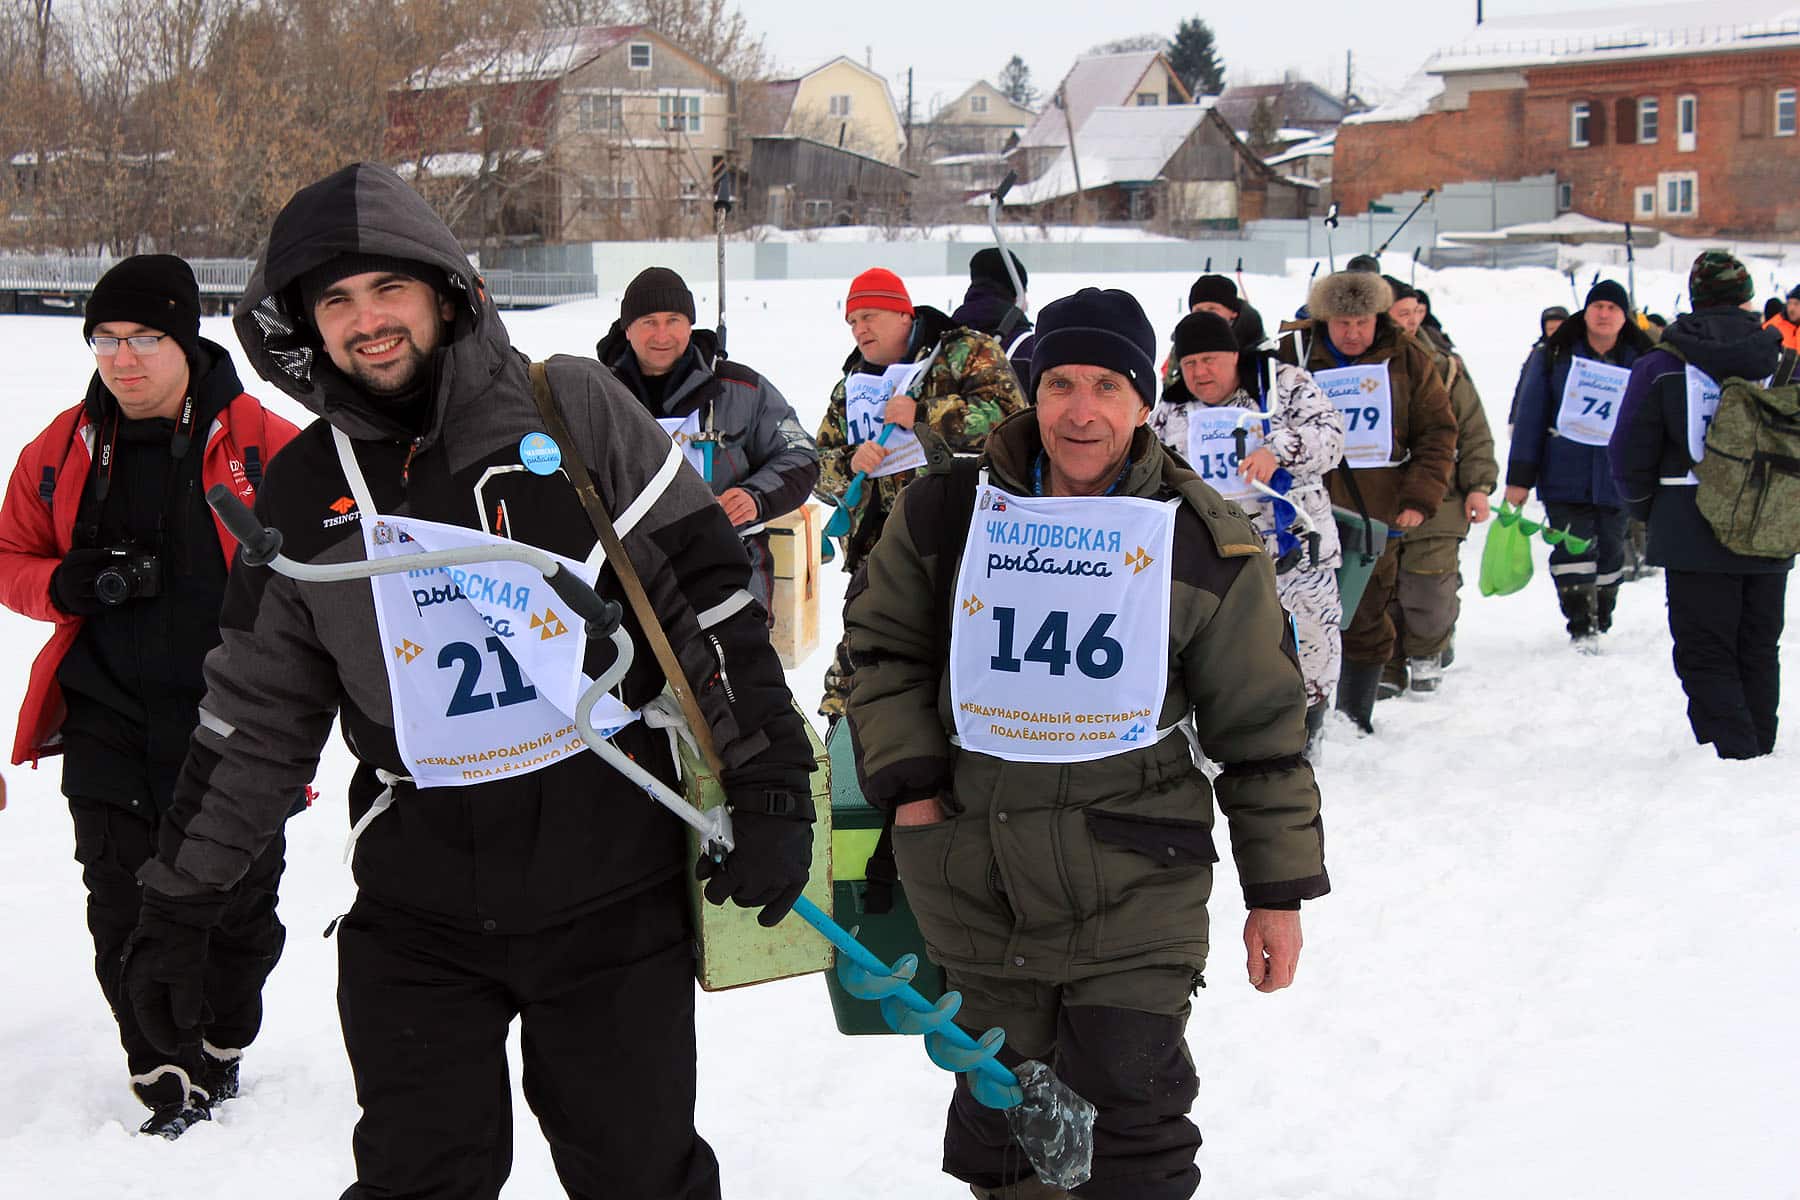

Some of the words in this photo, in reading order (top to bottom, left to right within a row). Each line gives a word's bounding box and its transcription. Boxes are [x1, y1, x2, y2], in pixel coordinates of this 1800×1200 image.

[182, 396, 192, 424] Canon
[1337, 407, 1380, 431] 79
[1581, 396, 1612, 420] 74
[102, 444, 111, 466] EOS
[323, 511, 362, 528] TISINGT
[985, 520, 1121, 552] ЧКАЛОВСКАЯ
[987, 547, 1112, 578] рыбалка
[990, 605, 1124, 680] 146
[436, 636, 538, 717] 21
[959, 702, 1072, 724] МЕЖДУНАРОДНЫЙ
[1074, 707, 1152, 725] ФЕСТИВАЛЬ
[990, 724, 1076, 742] ПОДЛЁДНОГО
[1078, 729, 1117, 742] ЛОВА
